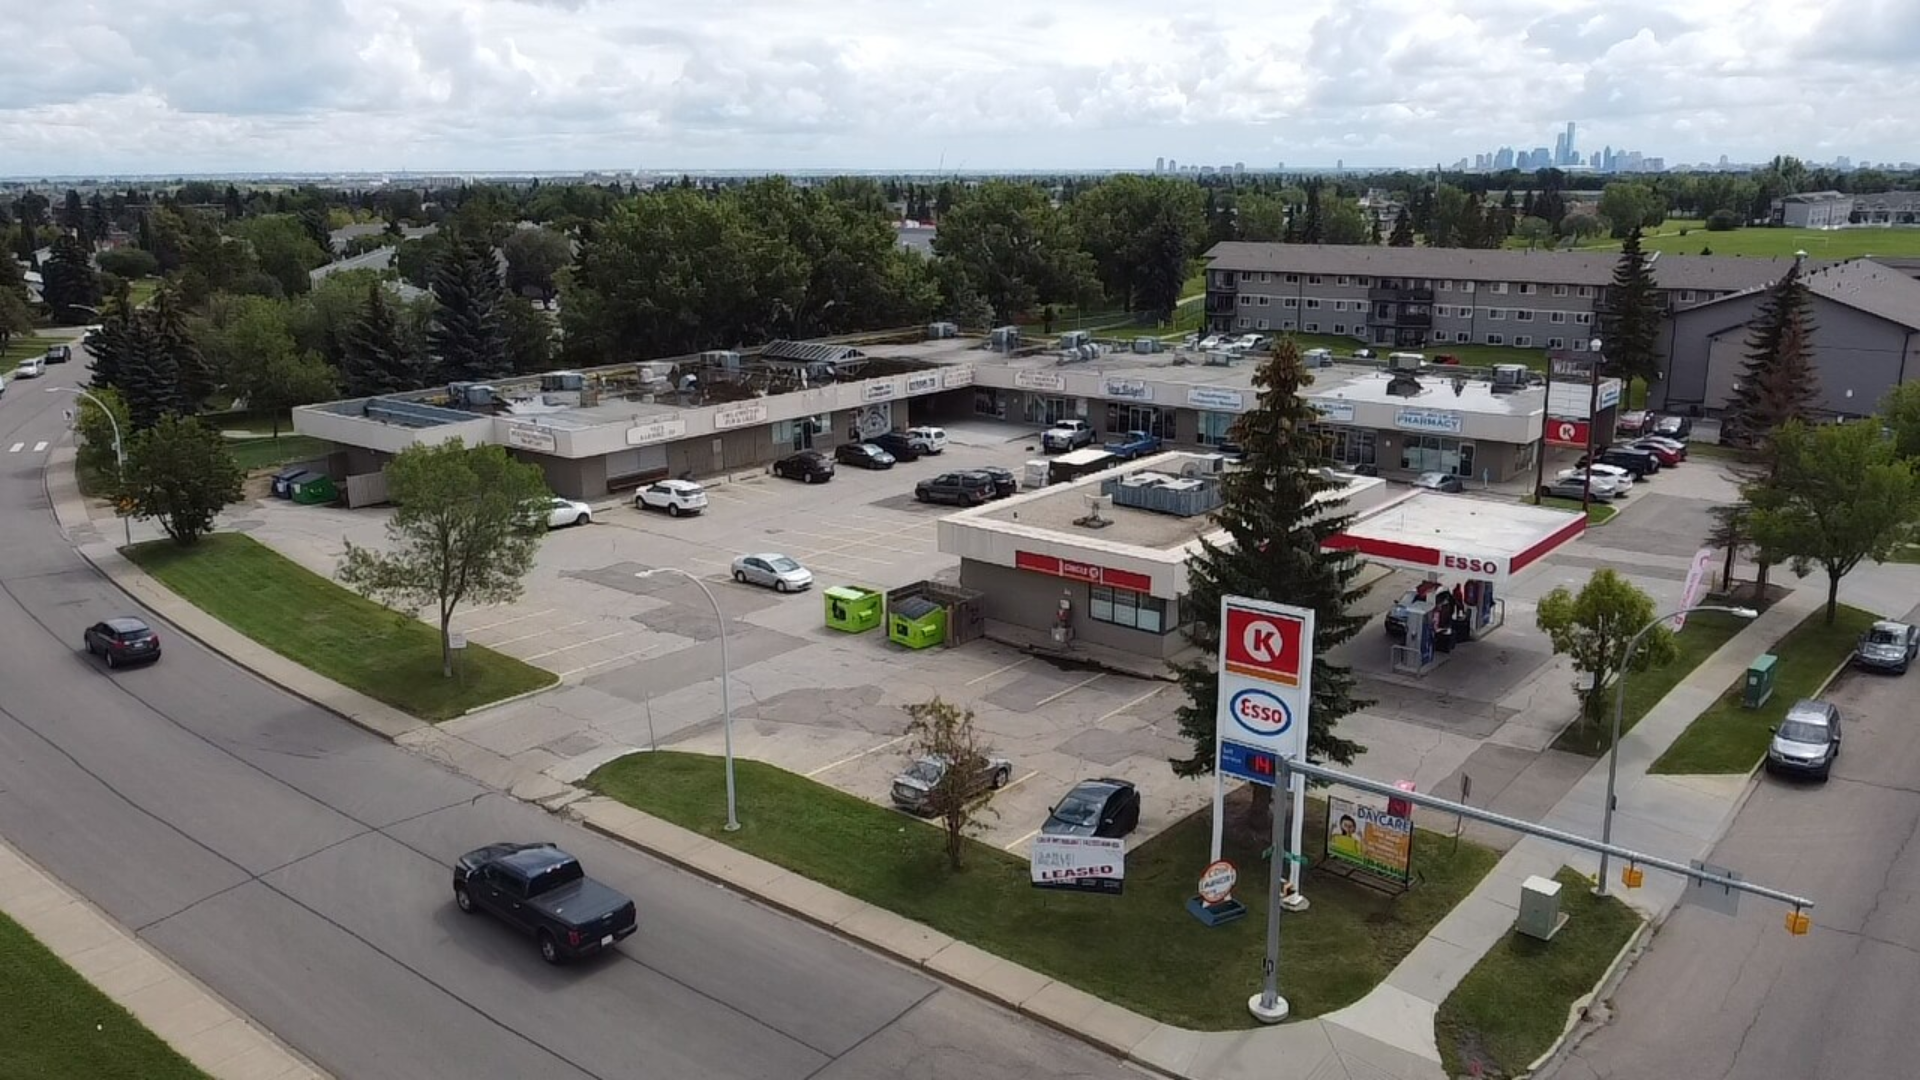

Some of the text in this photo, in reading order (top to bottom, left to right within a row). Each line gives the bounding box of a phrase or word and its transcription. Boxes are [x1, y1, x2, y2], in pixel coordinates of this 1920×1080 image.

[1397, 415, 1459, 428] PHARMACY
[1444, 555, 1497, 574] ESSO
[1253, 628, 1277, 662] K
[1357, 806, 1410, 832] DAYCARE
[1041, 864, 1114, 880] LEASED
